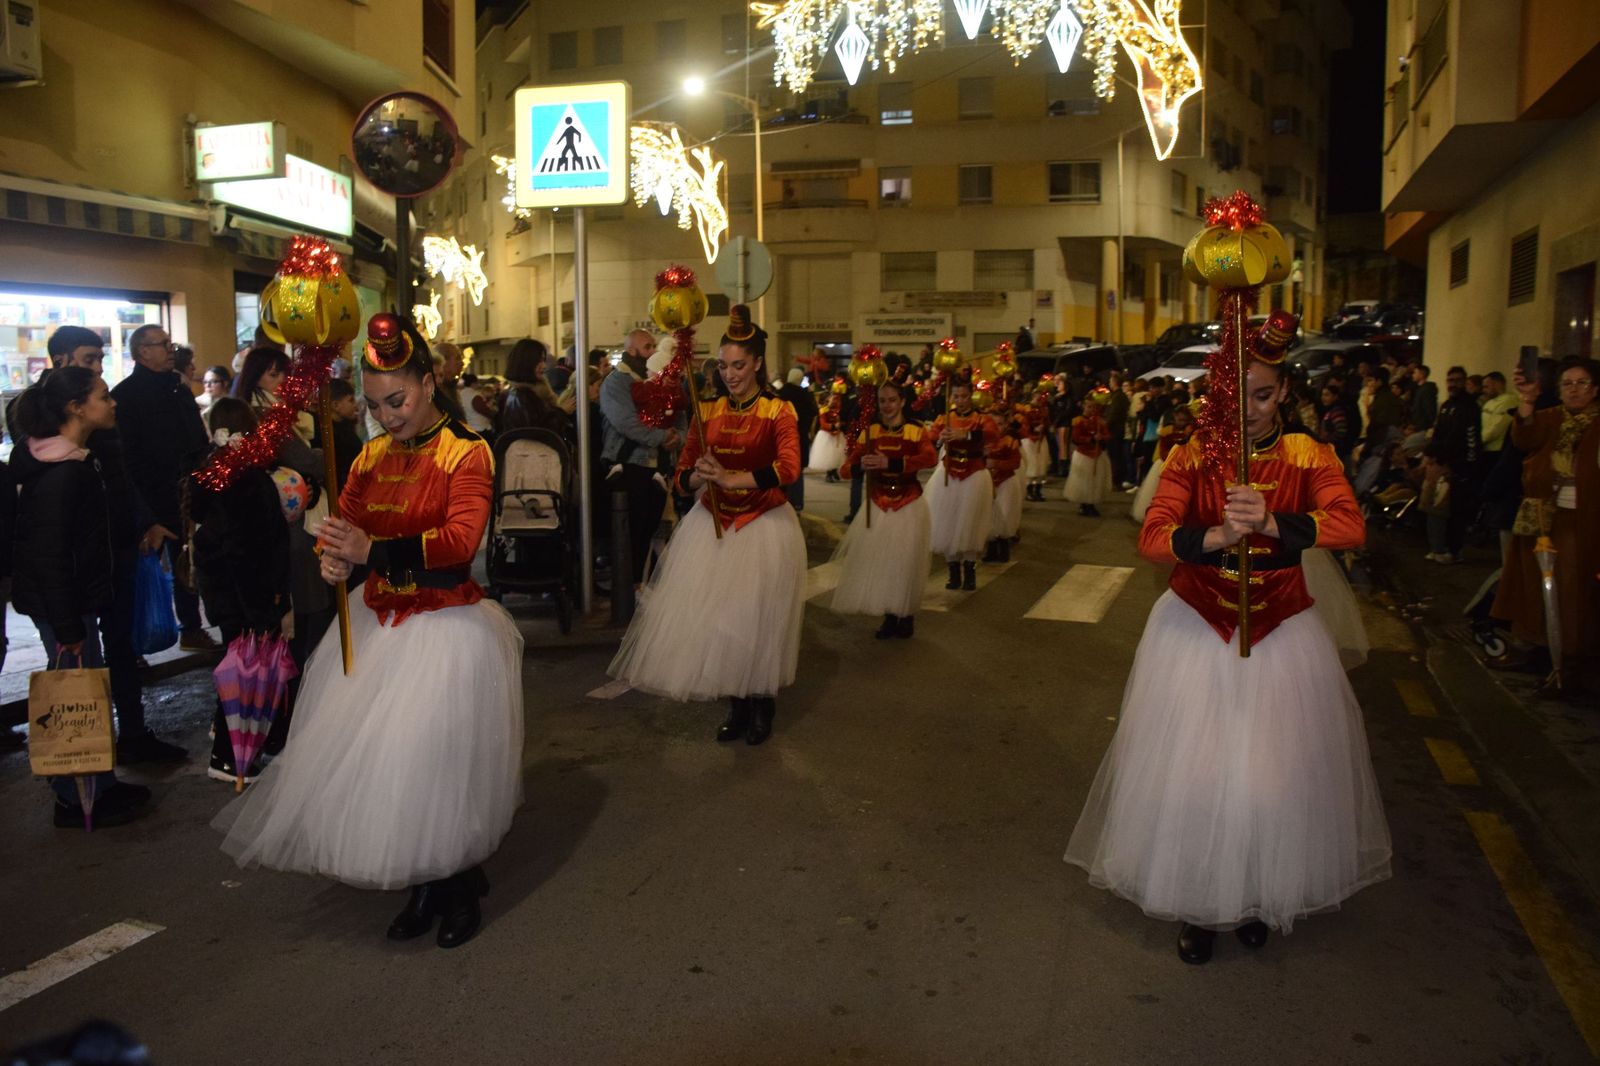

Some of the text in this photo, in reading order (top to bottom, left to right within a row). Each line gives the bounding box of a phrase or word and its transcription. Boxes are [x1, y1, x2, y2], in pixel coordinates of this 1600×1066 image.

[873, 328, 937, 336] FERNANDO PEREA
[53, 713, 96, 730] Beauty
